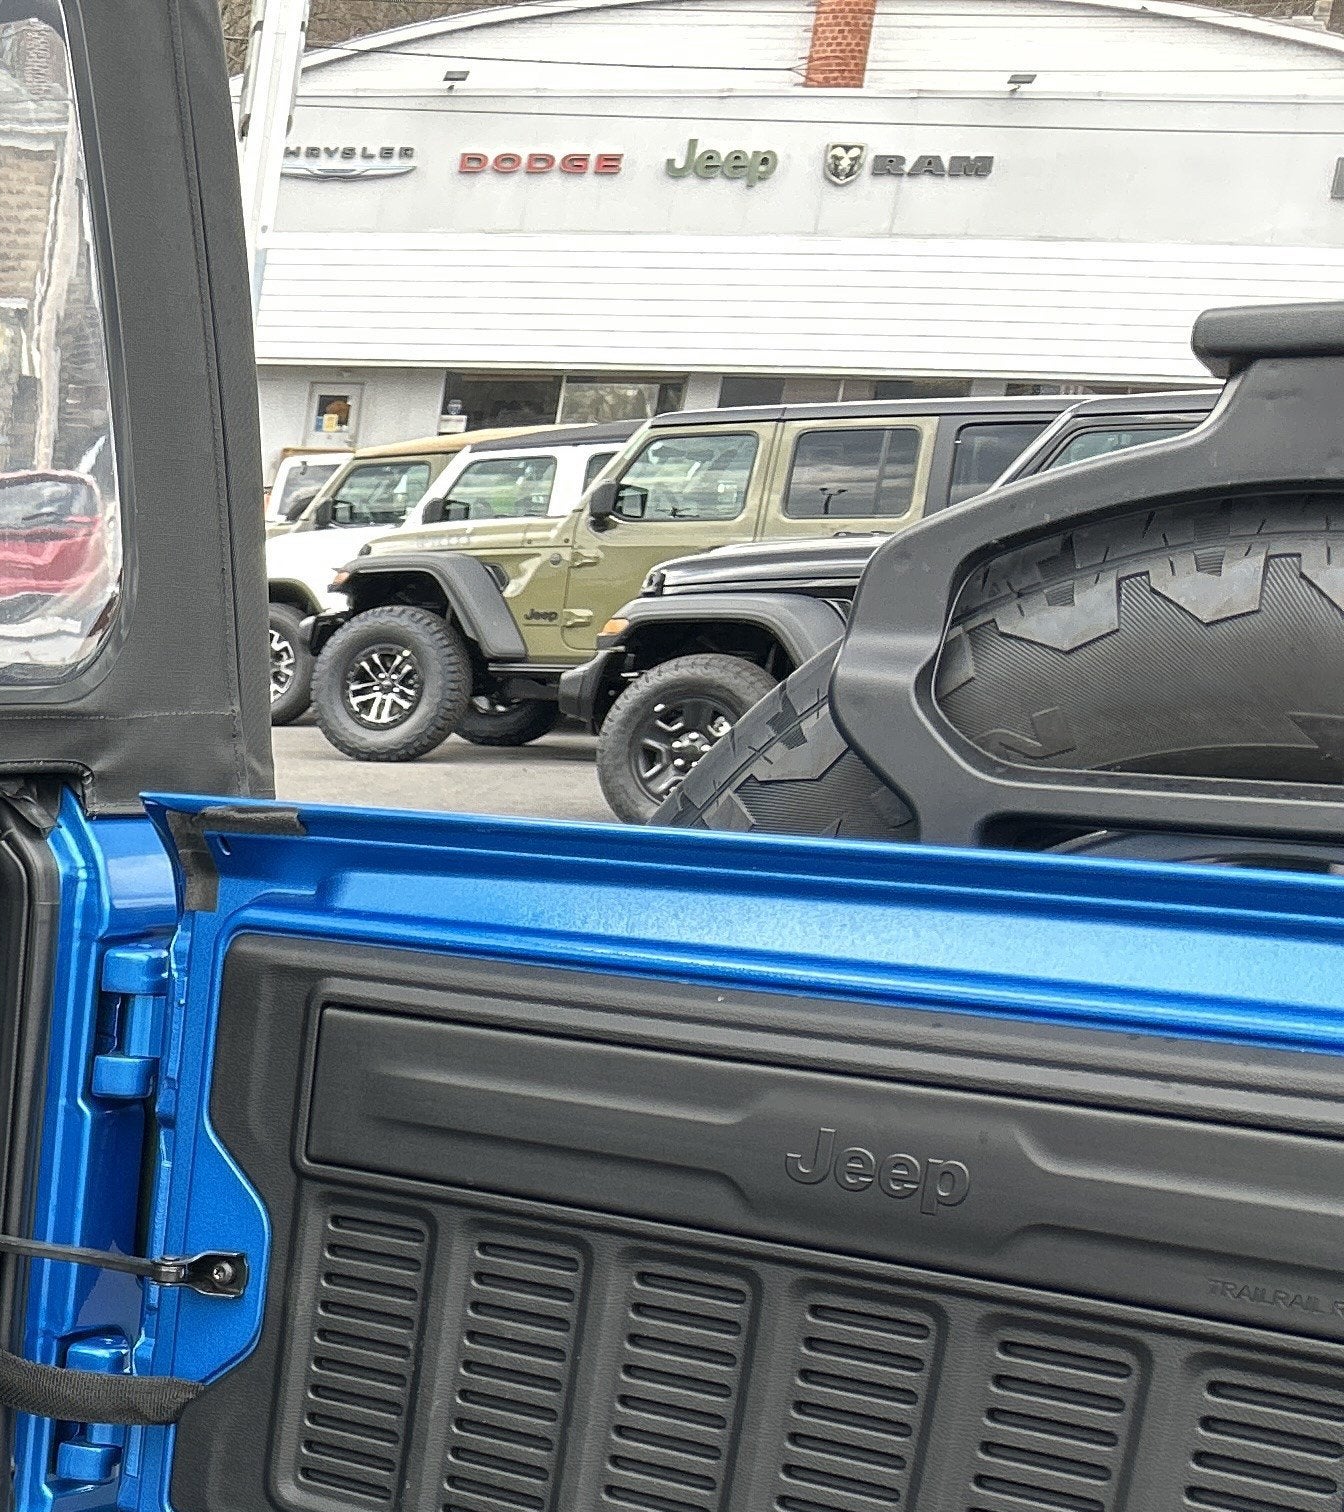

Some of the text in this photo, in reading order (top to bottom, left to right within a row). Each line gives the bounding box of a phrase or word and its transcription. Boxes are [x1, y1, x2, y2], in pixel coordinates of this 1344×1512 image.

[283, 146, 415, 160] HRYSLER
[458, 152, 624, 174] DODGE
[666, 138, 779, 187] Jeep
[871, 154, 995, 177] RAM
[524, 608, 558, 622] Jeep
[785, 1127, 970, 1216] Jeep
